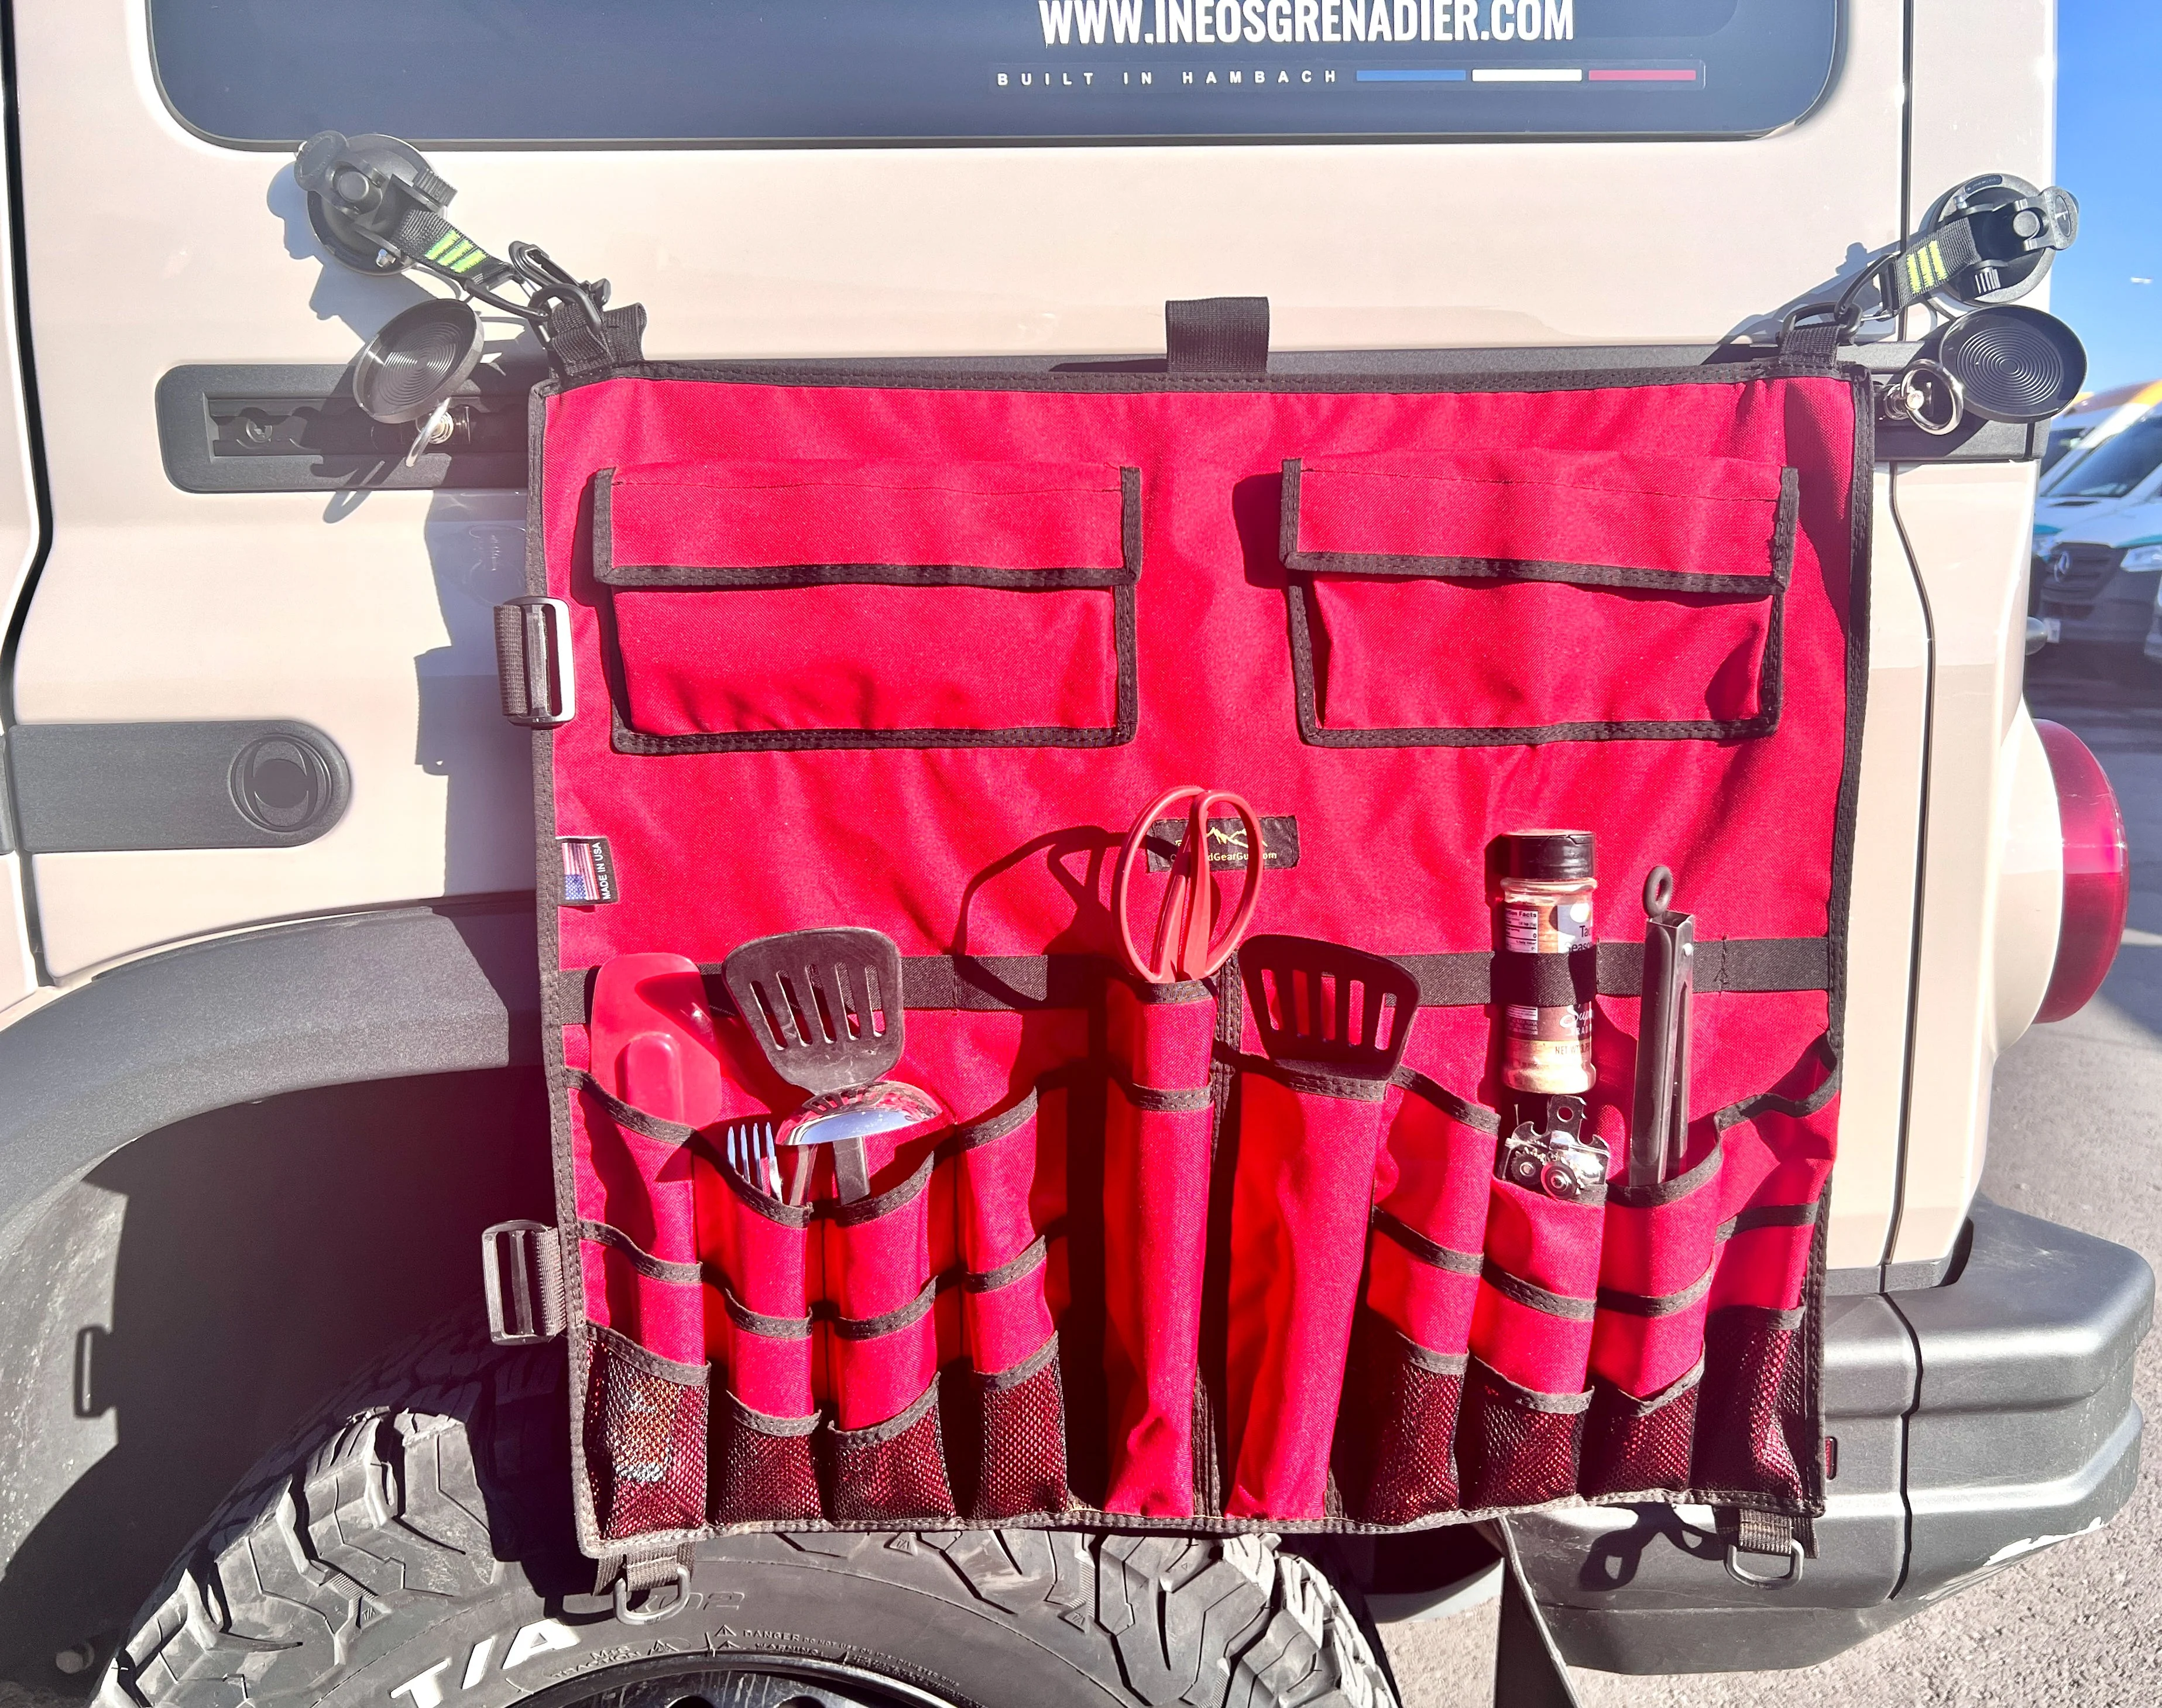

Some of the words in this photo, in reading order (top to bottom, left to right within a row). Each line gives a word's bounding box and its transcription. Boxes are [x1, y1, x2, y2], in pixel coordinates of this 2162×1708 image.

[1038, 0, 1574, 44] WWW.INEOSGRENADIER.COM
[997, 72, 1093, 85] BUILT
[1123, 71, 1152, 84] IN
[1182, 70, 1336, 84] HAMBACH
[592, 842, 603, 861] USA
[596, 863, 606, 873] IN
[598, 874, 612, 900] MADE
[1555, 1046, 1568, 1055] NET
[743, 1629, 801, 1642] DANGER
